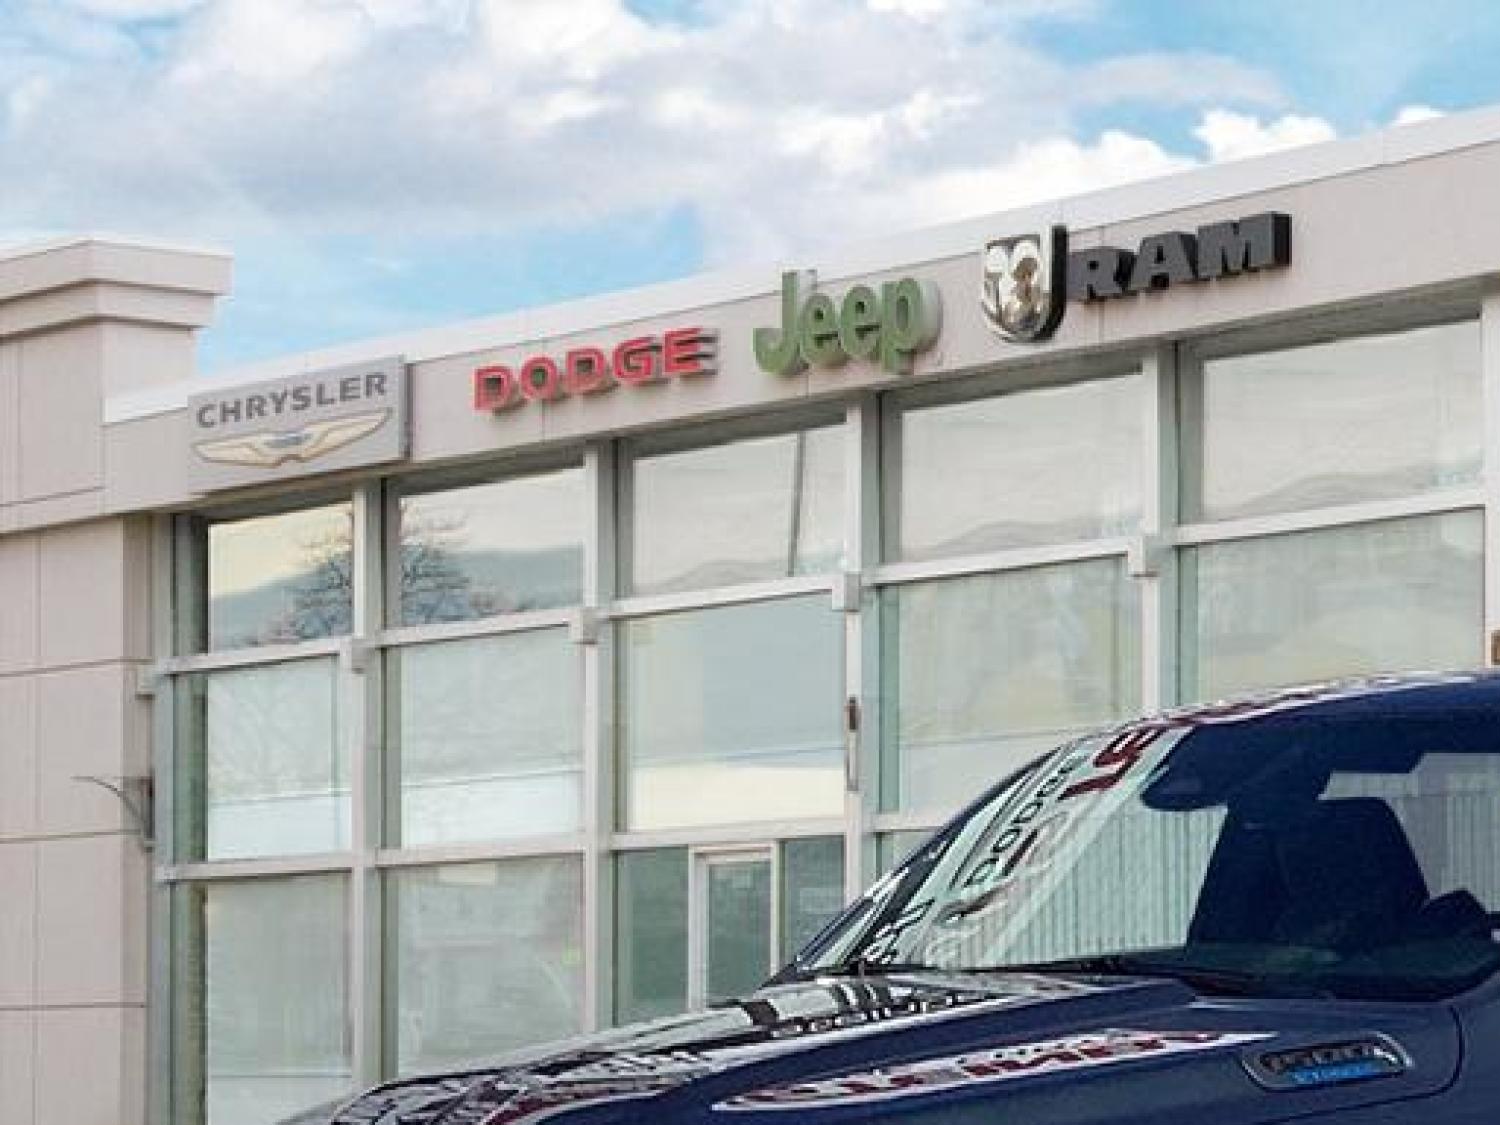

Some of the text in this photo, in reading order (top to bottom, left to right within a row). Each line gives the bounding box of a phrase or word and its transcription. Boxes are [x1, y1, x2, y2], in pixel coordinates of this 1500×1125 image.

[1066, 212, 1292, 302] RAM
[753, 269, 938, 376] Jeep
[197, 371, 389, 430] CHRYSLER
[473, 326, 712, 413] DODGE
